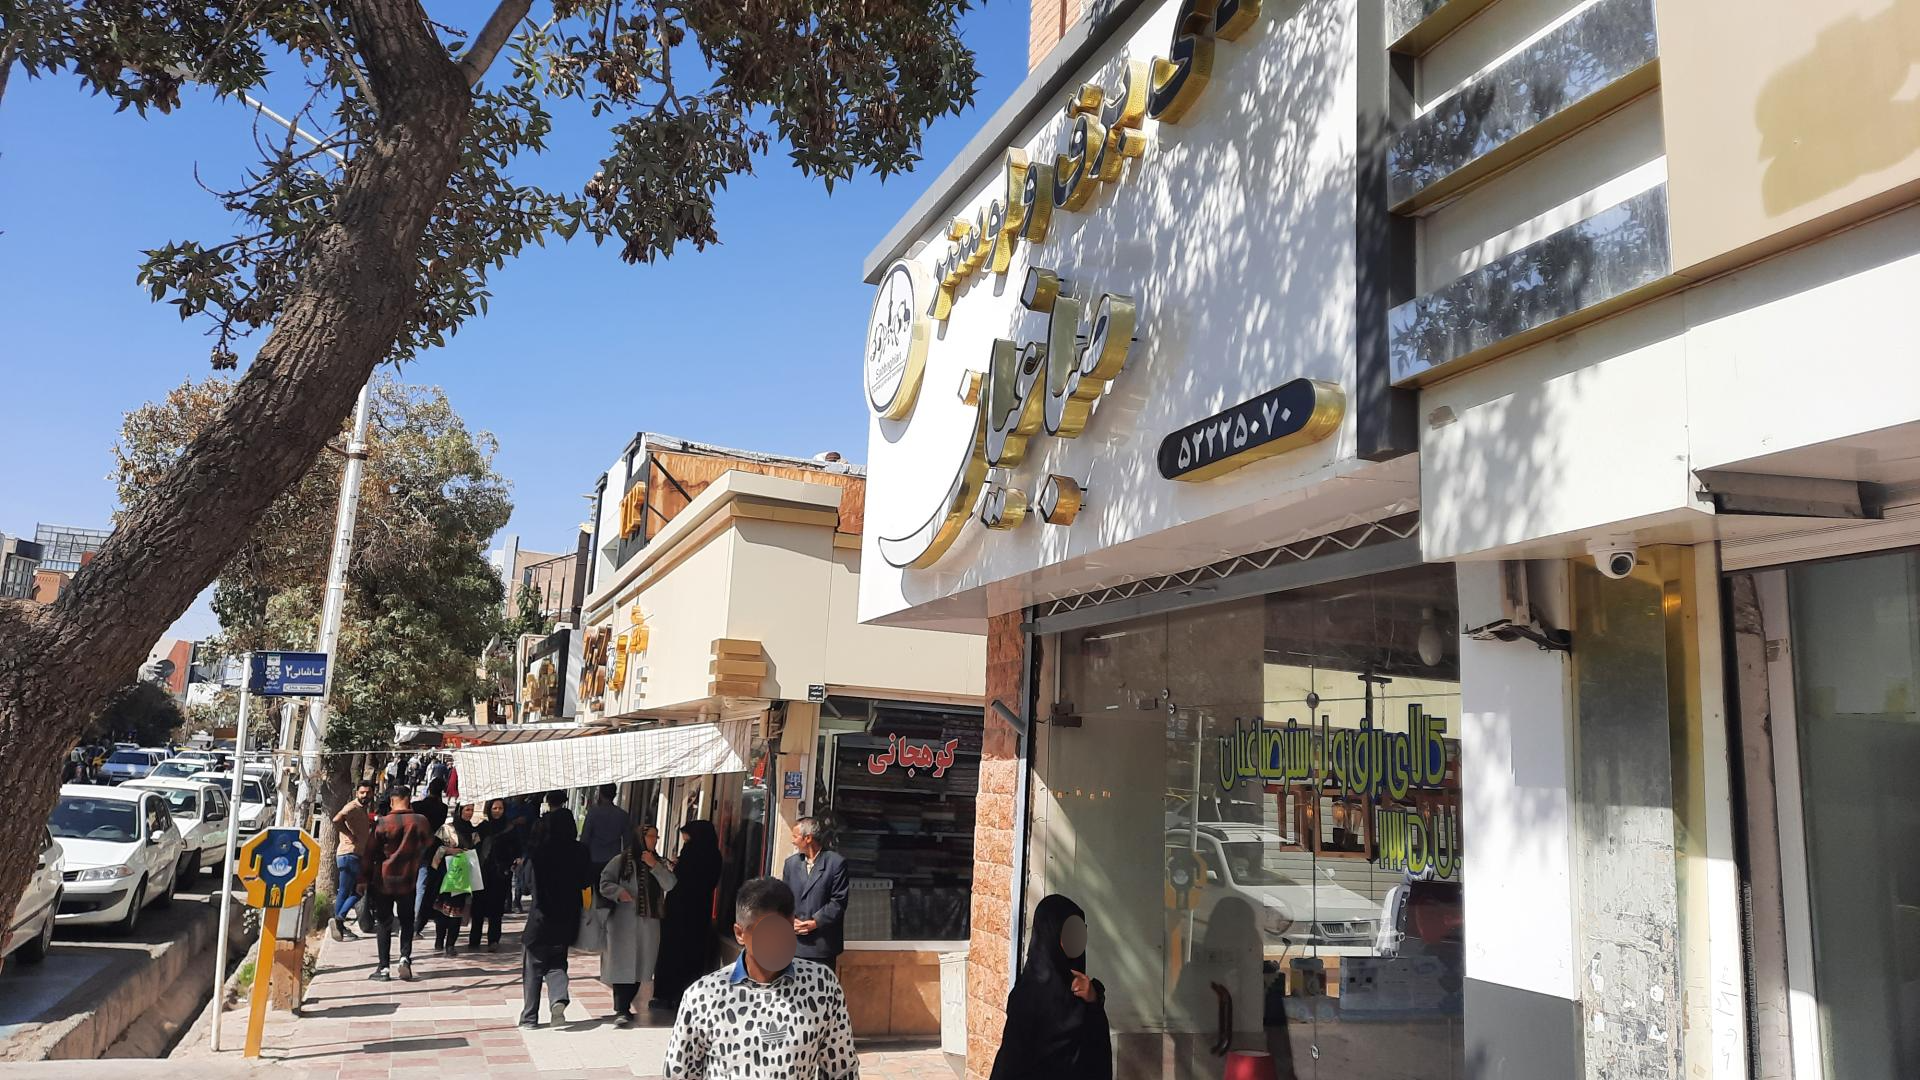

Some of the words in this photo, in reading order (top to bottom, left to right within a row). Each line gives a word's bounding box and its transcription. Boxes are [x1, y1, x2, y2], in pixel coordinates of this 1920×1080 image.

[1053, 59, 1148, 214] برق
[926, 146, 1030, 321] لوستر
[1017, 161, 1055, 244] و
[877, 265, 1138, 571] صباغیان
[867, 732, 959, 778] کوهجانی
[1385, 703, 1449, 801] کالای
